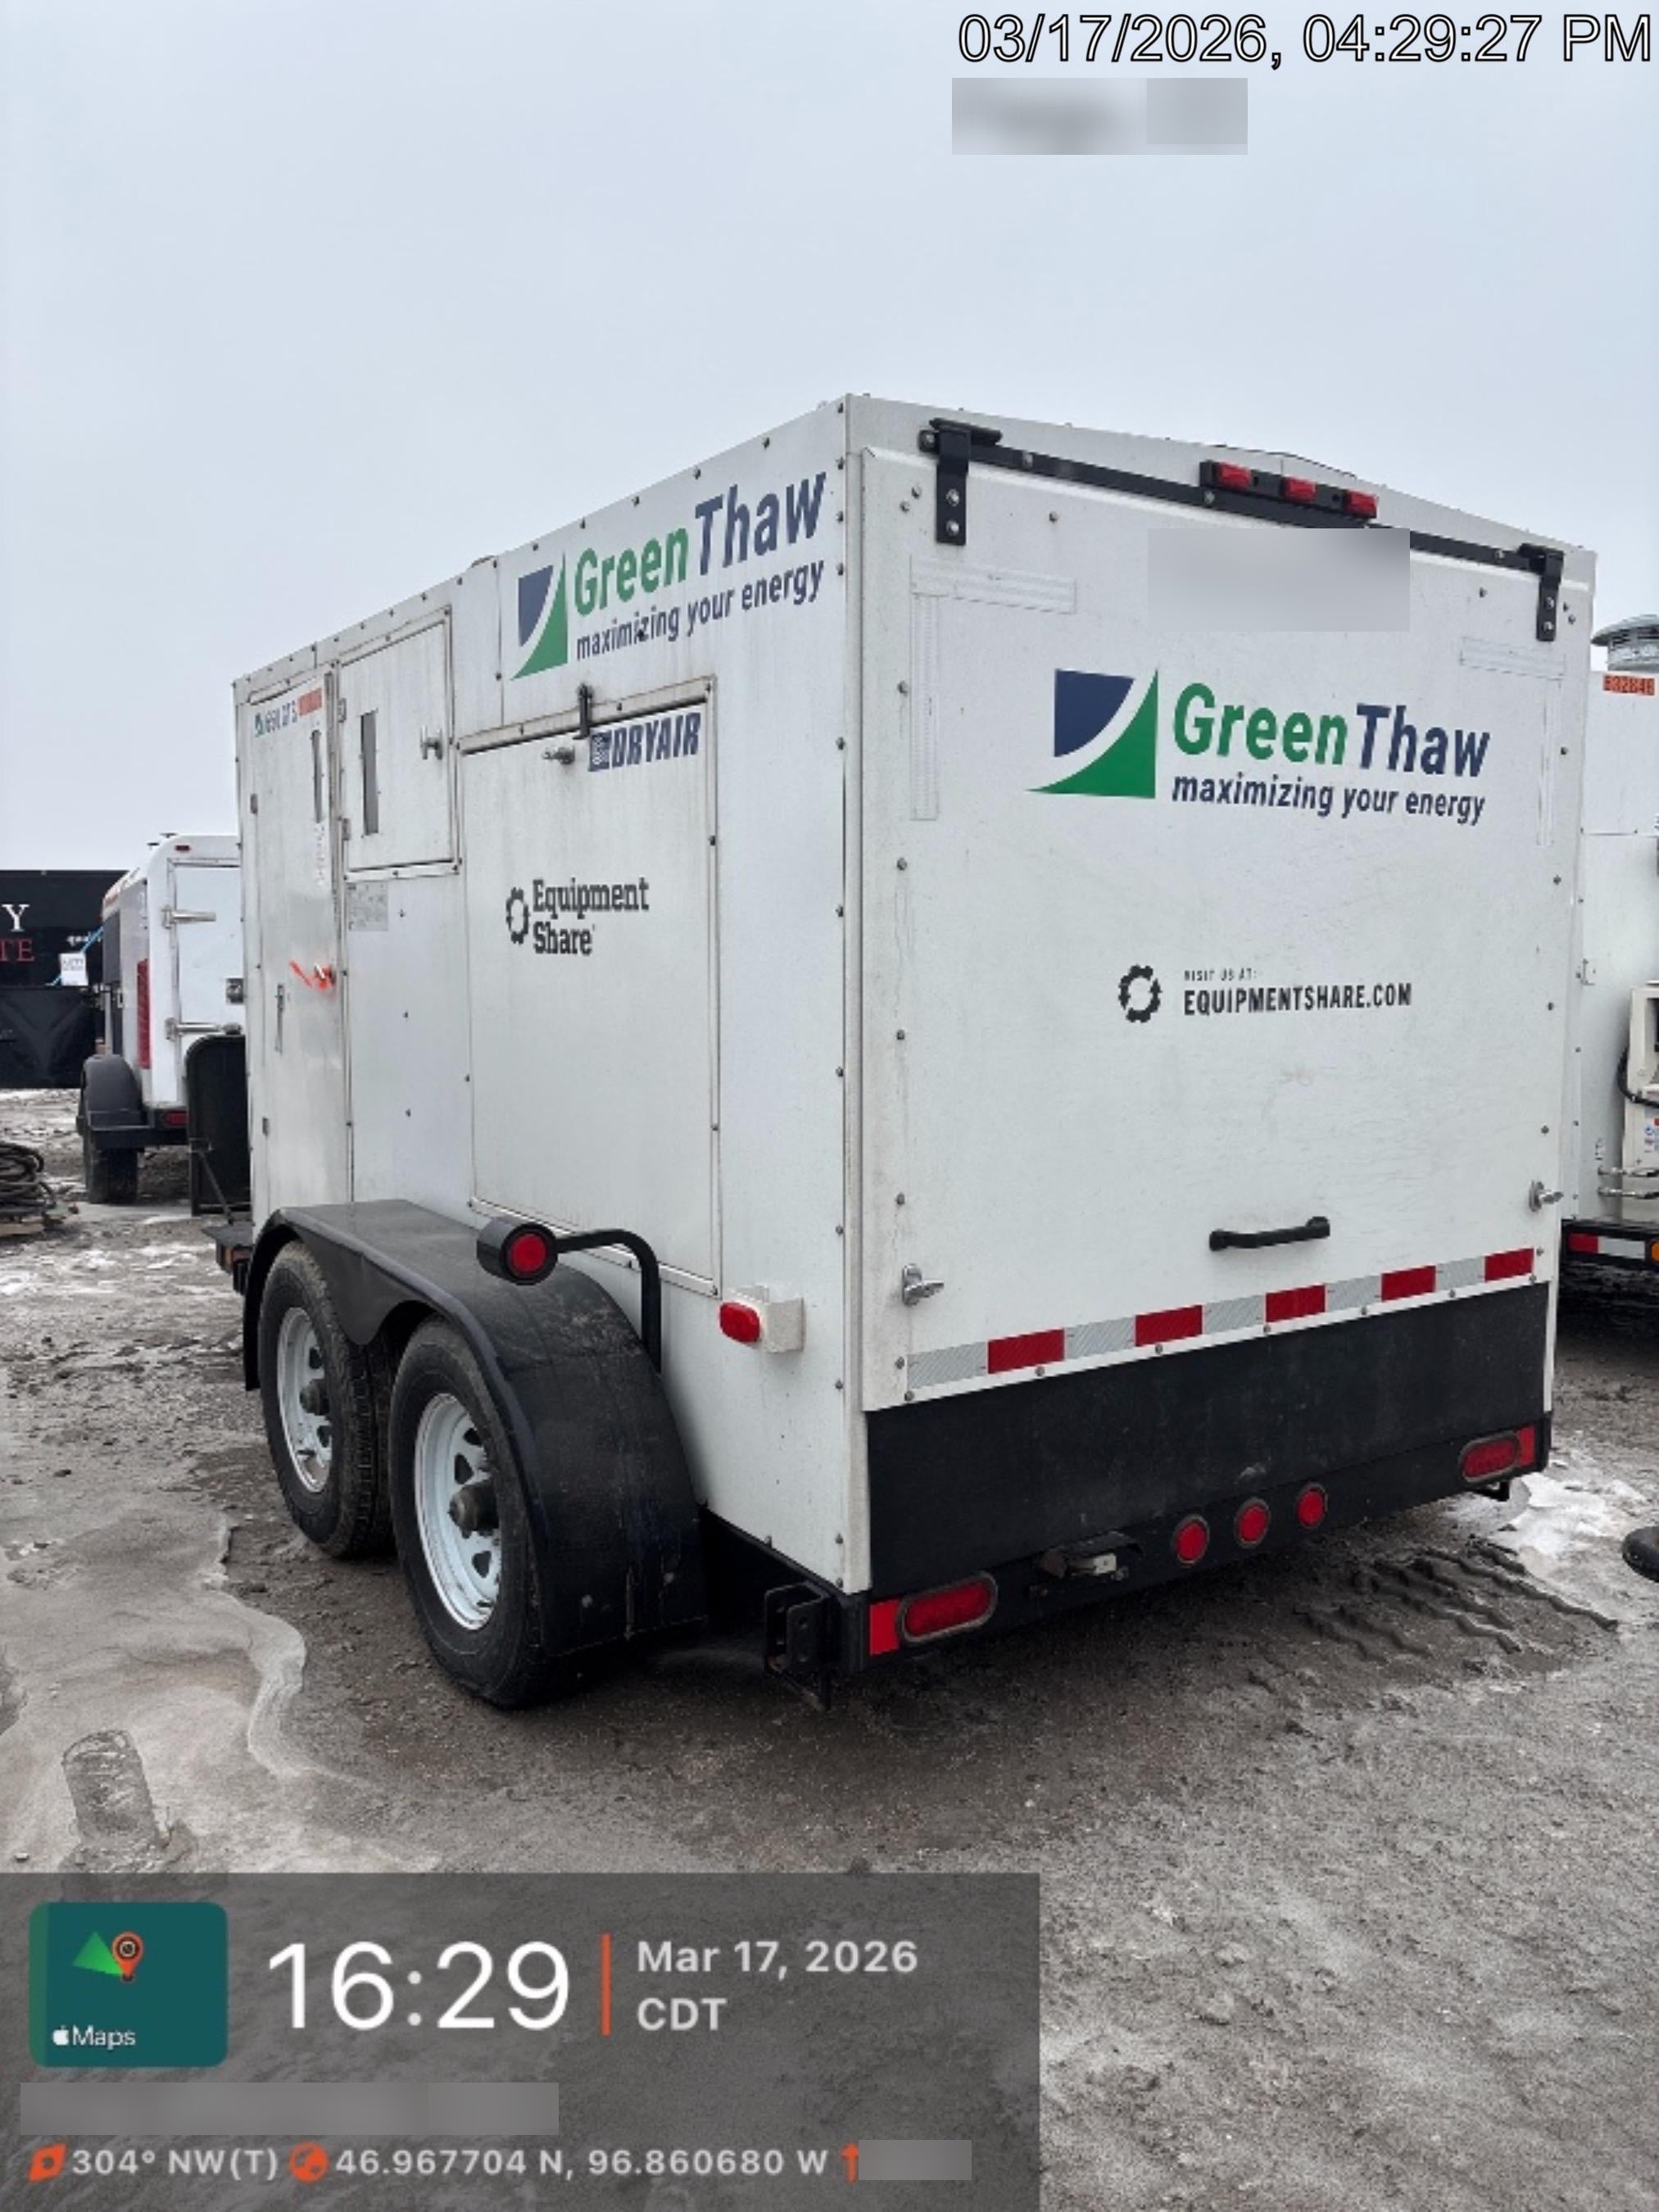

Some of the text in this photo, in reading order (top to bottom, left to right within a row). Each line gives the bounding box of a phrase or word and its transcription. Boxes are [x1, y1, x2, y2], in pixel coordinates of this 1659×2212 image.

[577, 560, 824, 660] maximizing your energy
[612, 712, 700, 768] DRYAIR
[1172, 772, 1484, 826] maximizing your energy
[533, 877, 649, 919] Equipment
[533, 921, 592, 956] Share
[1184, 968, 1216, 981] VISIT
[1220, 968, 1235, 981] US
[1184, 983, 1412, 1016] EQUIPMENTSHARE.COM
